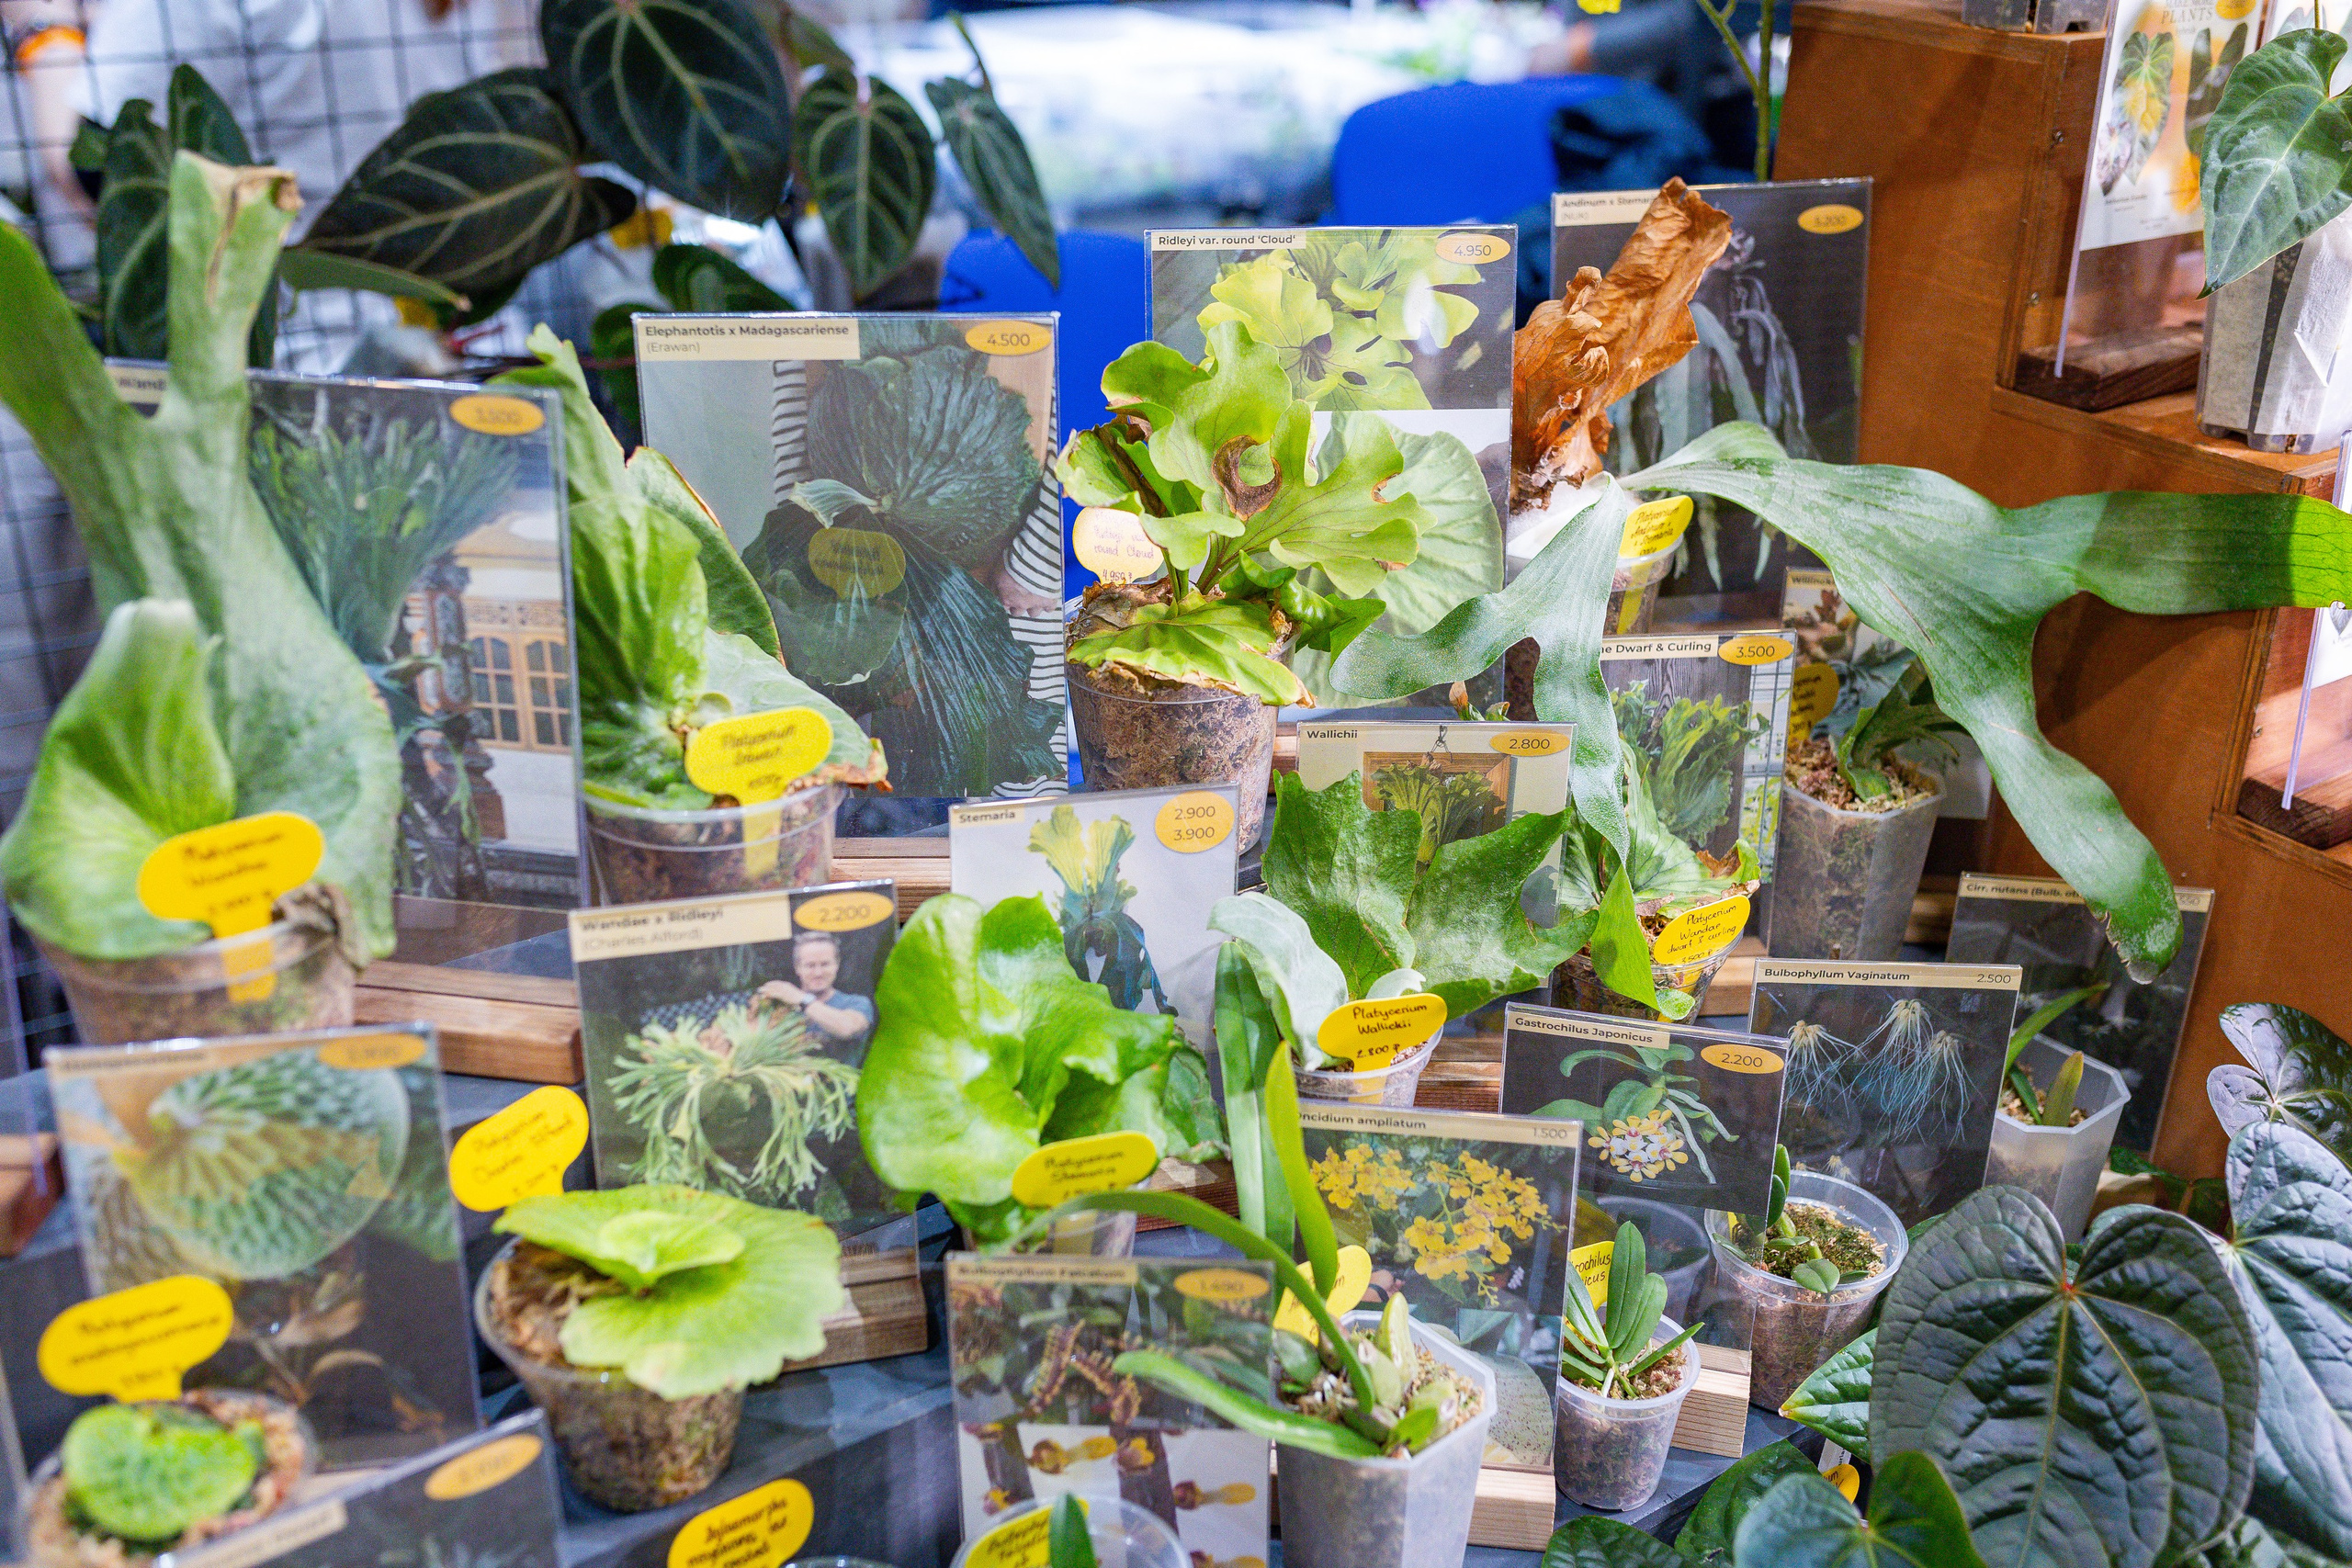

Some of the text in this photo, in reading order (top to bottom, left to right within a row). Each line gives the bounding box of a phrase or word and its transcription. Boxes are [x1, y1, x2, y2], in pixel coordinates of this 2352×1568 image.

[2160, 8, 2213, 24] PLANTS
[1159, 234, 1196, 247] Ridleyi
[1198, 237, 1220, 245] var.
[1222, 235, 1255, 245] round
[1453, 243, 1493, 257] 4.950
[645, 324, 850, 338] Elephantotis x Madagascariense
[986, 332, 1031, 347] 4.500
[646, 340, 701, 355] (Erawan)
[1615, 642, 1654, 654] Dwarf
[1656, 642, 1665, 651] &
[1667, 640, 1713, 655] Curling
[1736, 644, 1776, 659] 3.500
[1306, 728, 1358, 739] Wallichii
[1509, 738, 1551, 750] 2.800
[958, 809, 1016, 824] Stemaria
[1174, 806, 1216, 820] 2.900
[1174, 826, 1216, 841] 3.900
[817, 903, 872, 925] 2.200
[1687, 905, 1737, 926] Platycerium
[1764, 967, 1911, 983] Bulbophyllum Vaginatum
[1976, 973, 2012, 985] 2.500
[1352, 1004, 1428, 1021] Platycerium
[1515, 1016, 1654, 1044] Gastrochilus Japonicus
[1721, 1052, 1763, 1068] 2.200
[1357, 1115, 1427, 1130] ampliatum
[1532, 1127, 1568, 1140] 1.500
